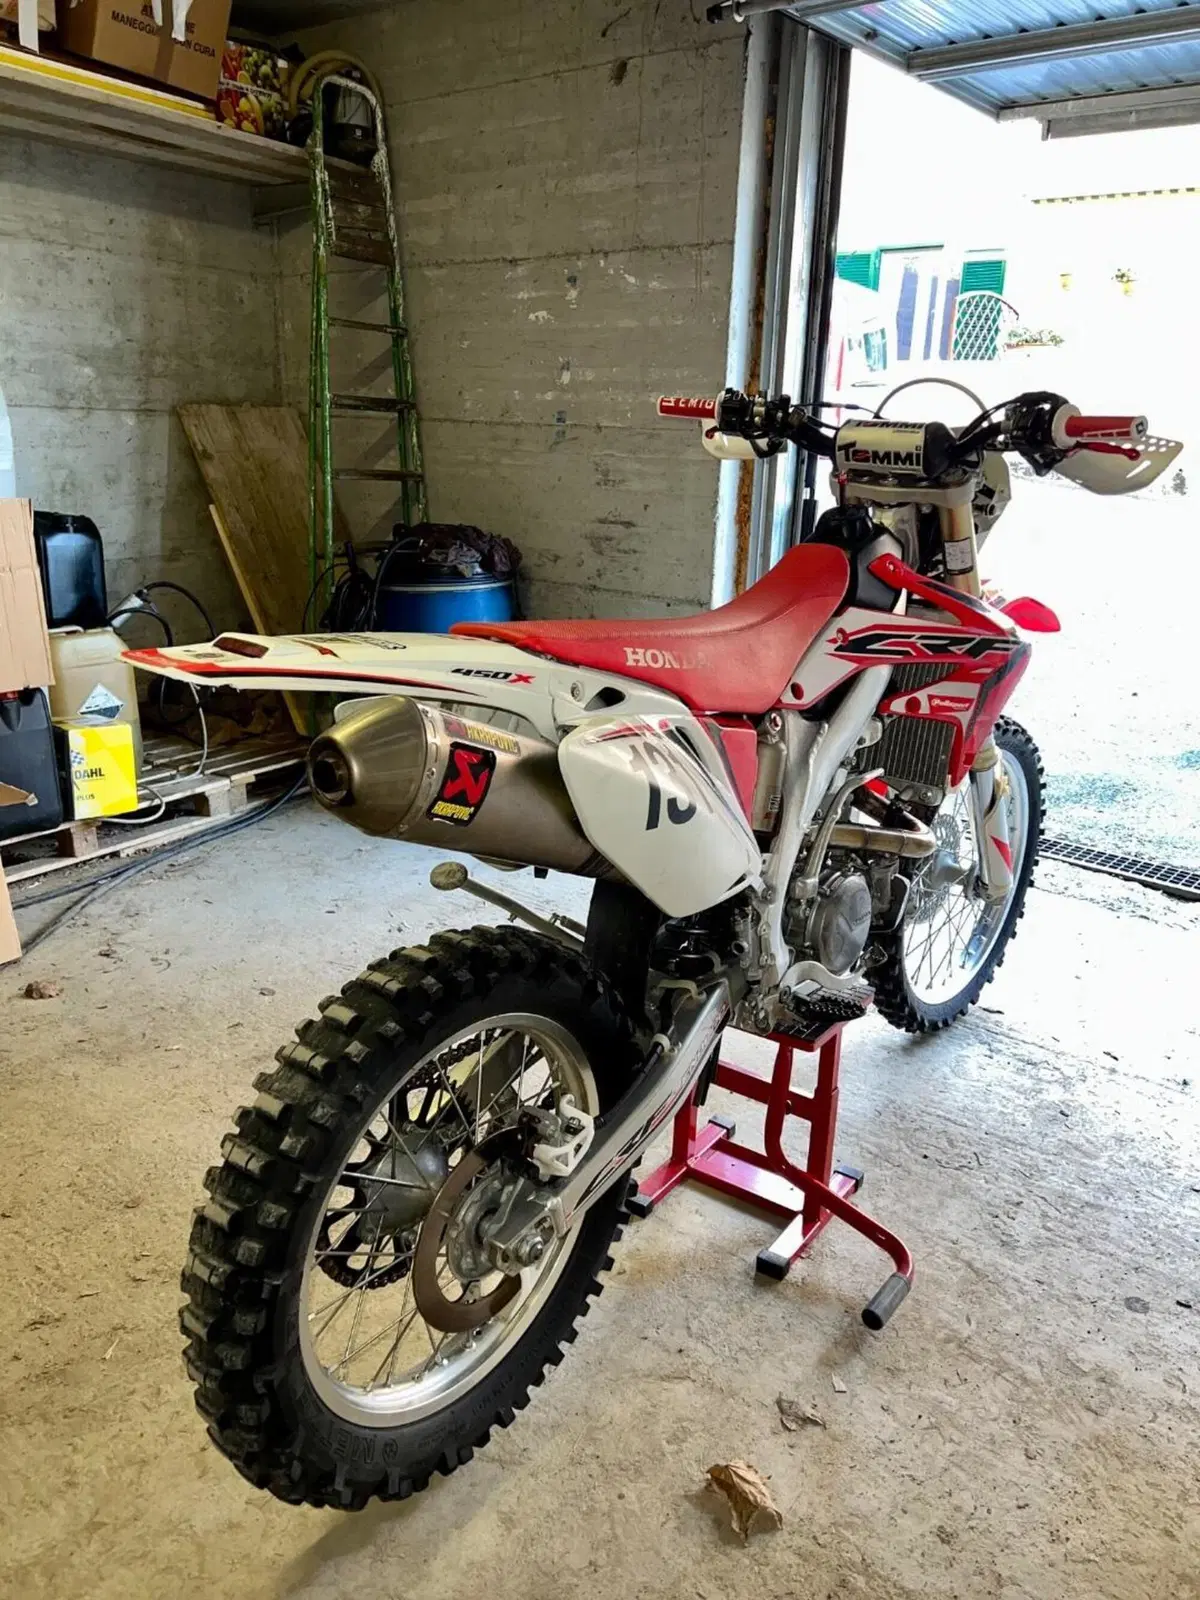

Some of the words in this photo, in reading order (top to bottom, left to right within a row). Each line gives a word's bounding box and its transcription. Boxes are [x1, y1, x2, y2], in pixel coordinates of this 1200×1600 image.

[193, 42, 216, 57] CURA
[450, 667, 536, 684] 450X
[75, 767, 105, 780] DAHL
